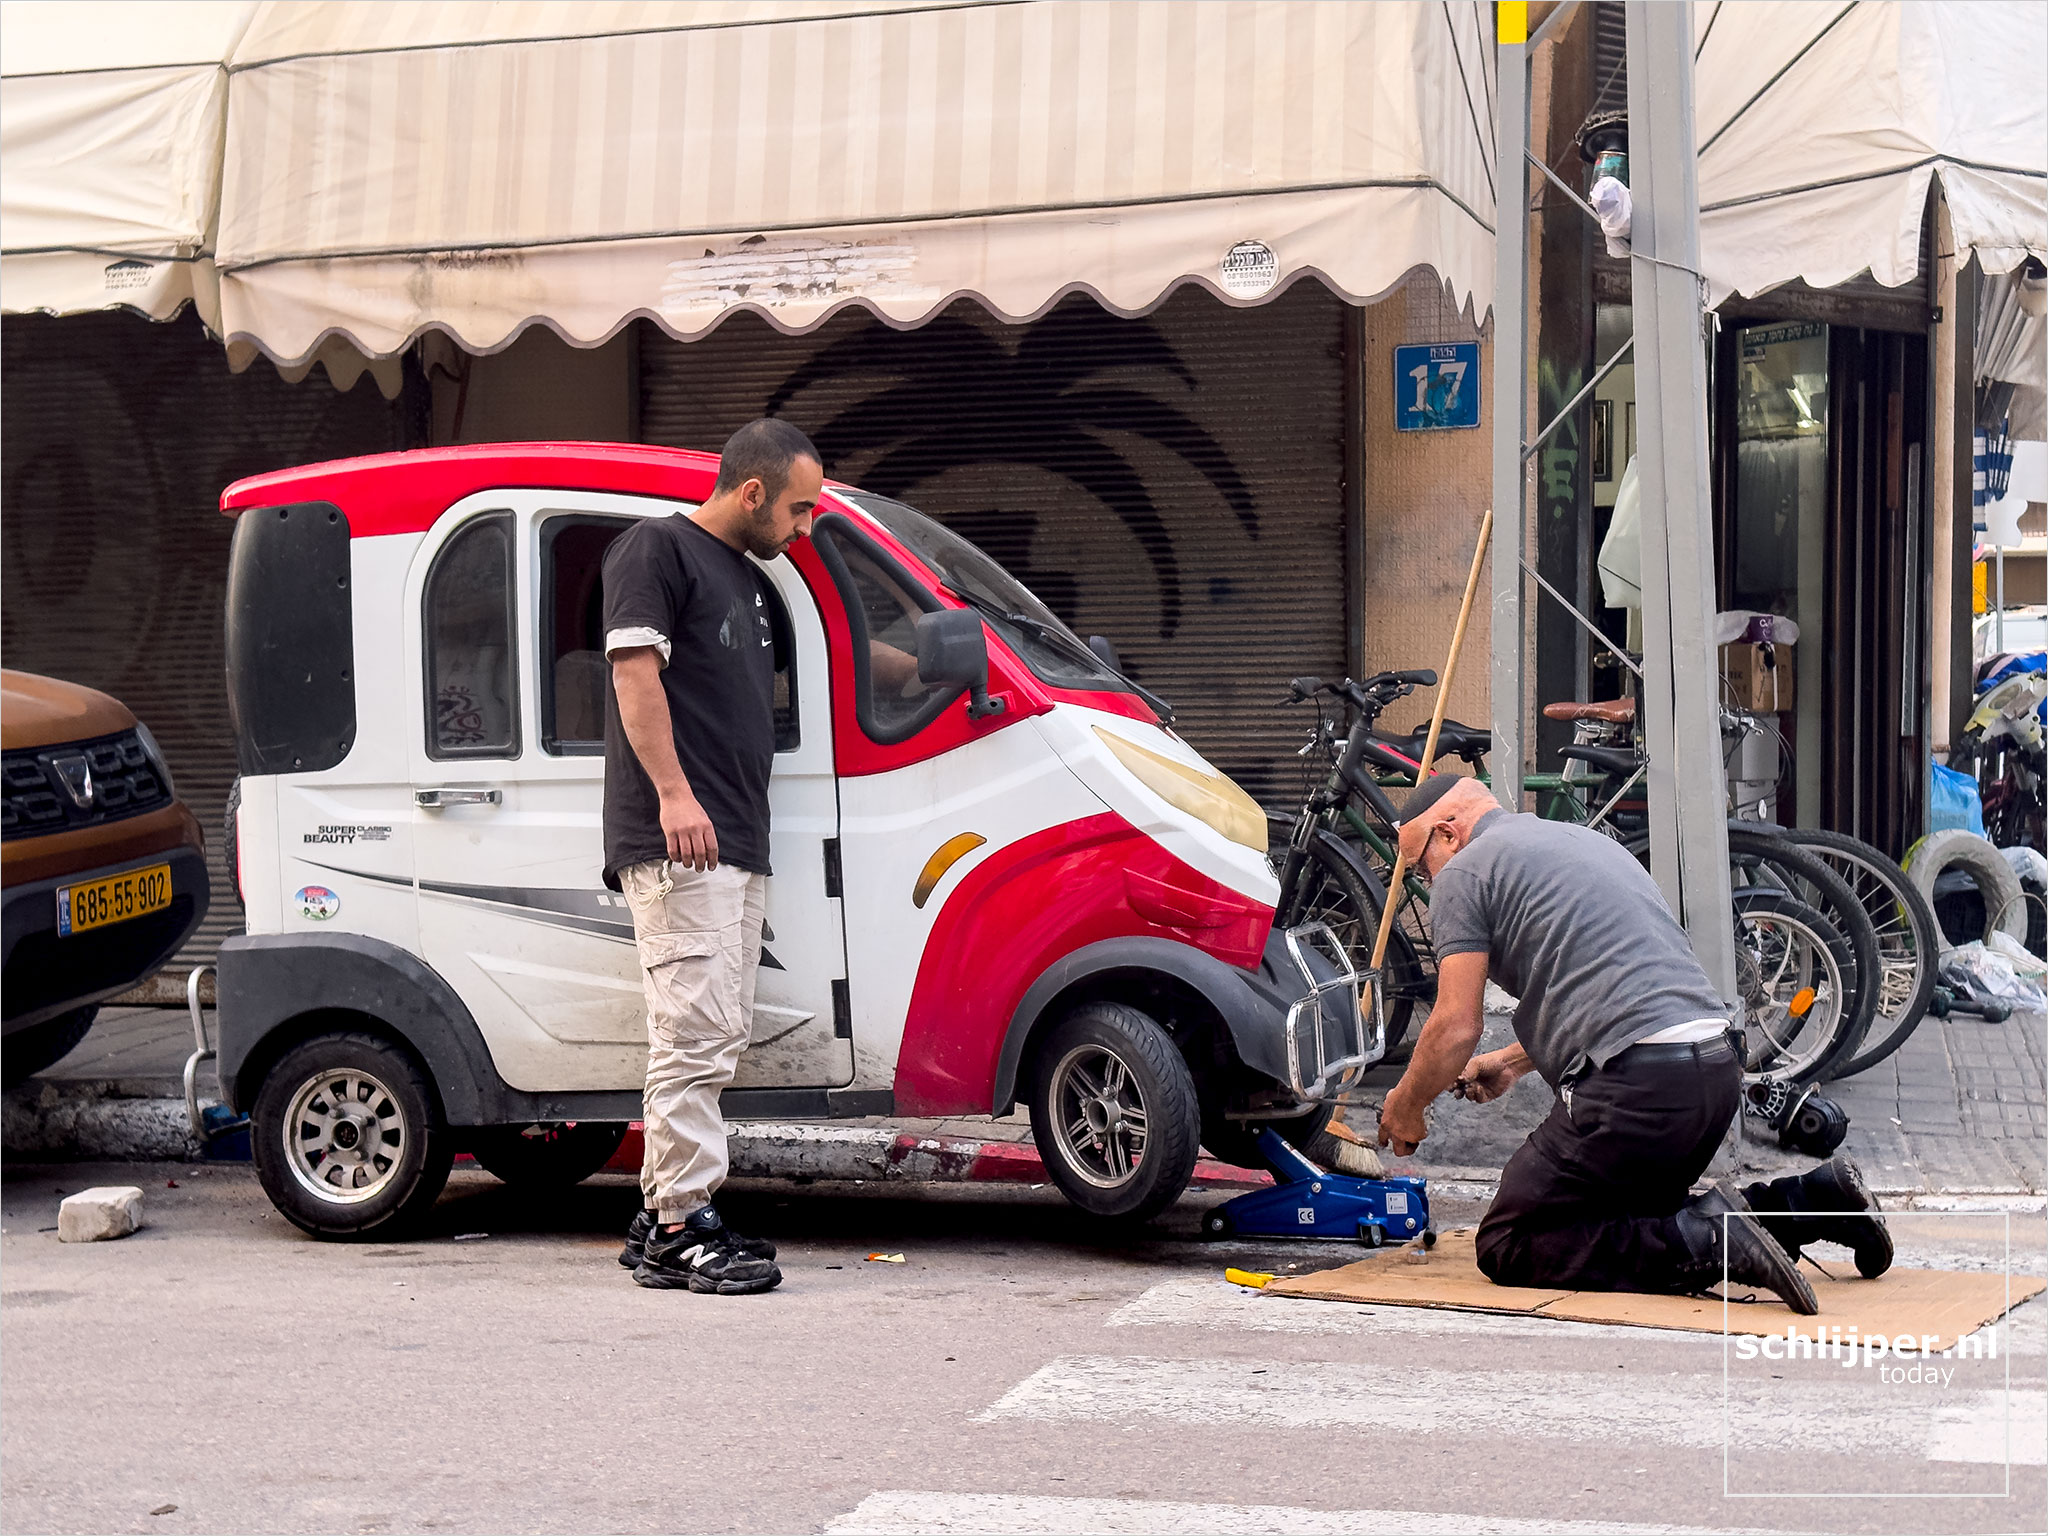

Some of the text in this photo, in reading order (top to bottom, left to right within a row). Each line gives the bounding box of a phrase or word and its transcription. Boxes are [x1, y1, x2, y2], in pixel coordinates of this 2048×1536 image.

[1408, 362, 1468, 412] 17
[318, 825, 356, 834] SUPER
[303, 834, 355, 844] BEAUTY
